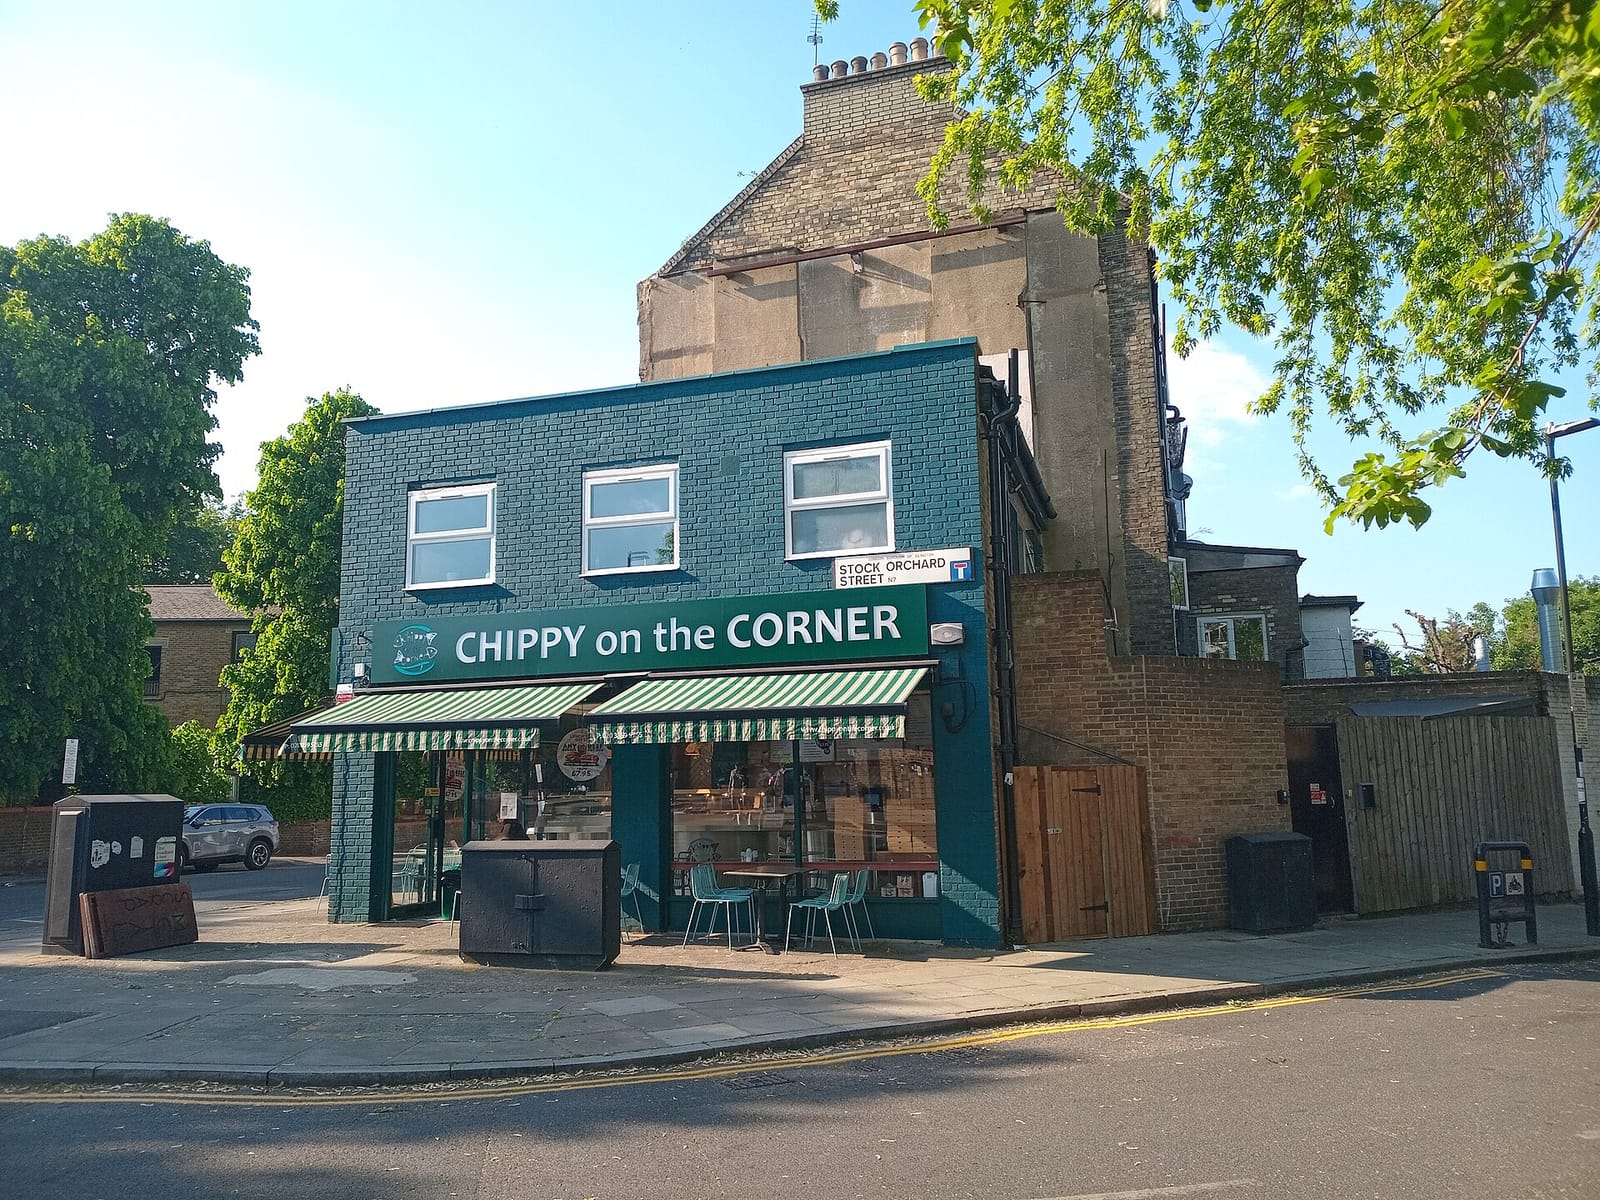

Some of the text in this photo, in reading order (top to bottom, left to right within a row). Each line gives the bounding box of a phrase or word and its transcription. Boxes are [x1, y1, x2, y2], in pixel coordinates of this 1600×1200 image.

[839, 557, 946, 575] STOCK ORCHARD
[840, 574, 884, 587] STREET
[455, 605, 902, 664] CHIPPY on the CORNER
[1492, 875, 1501, 895] P
